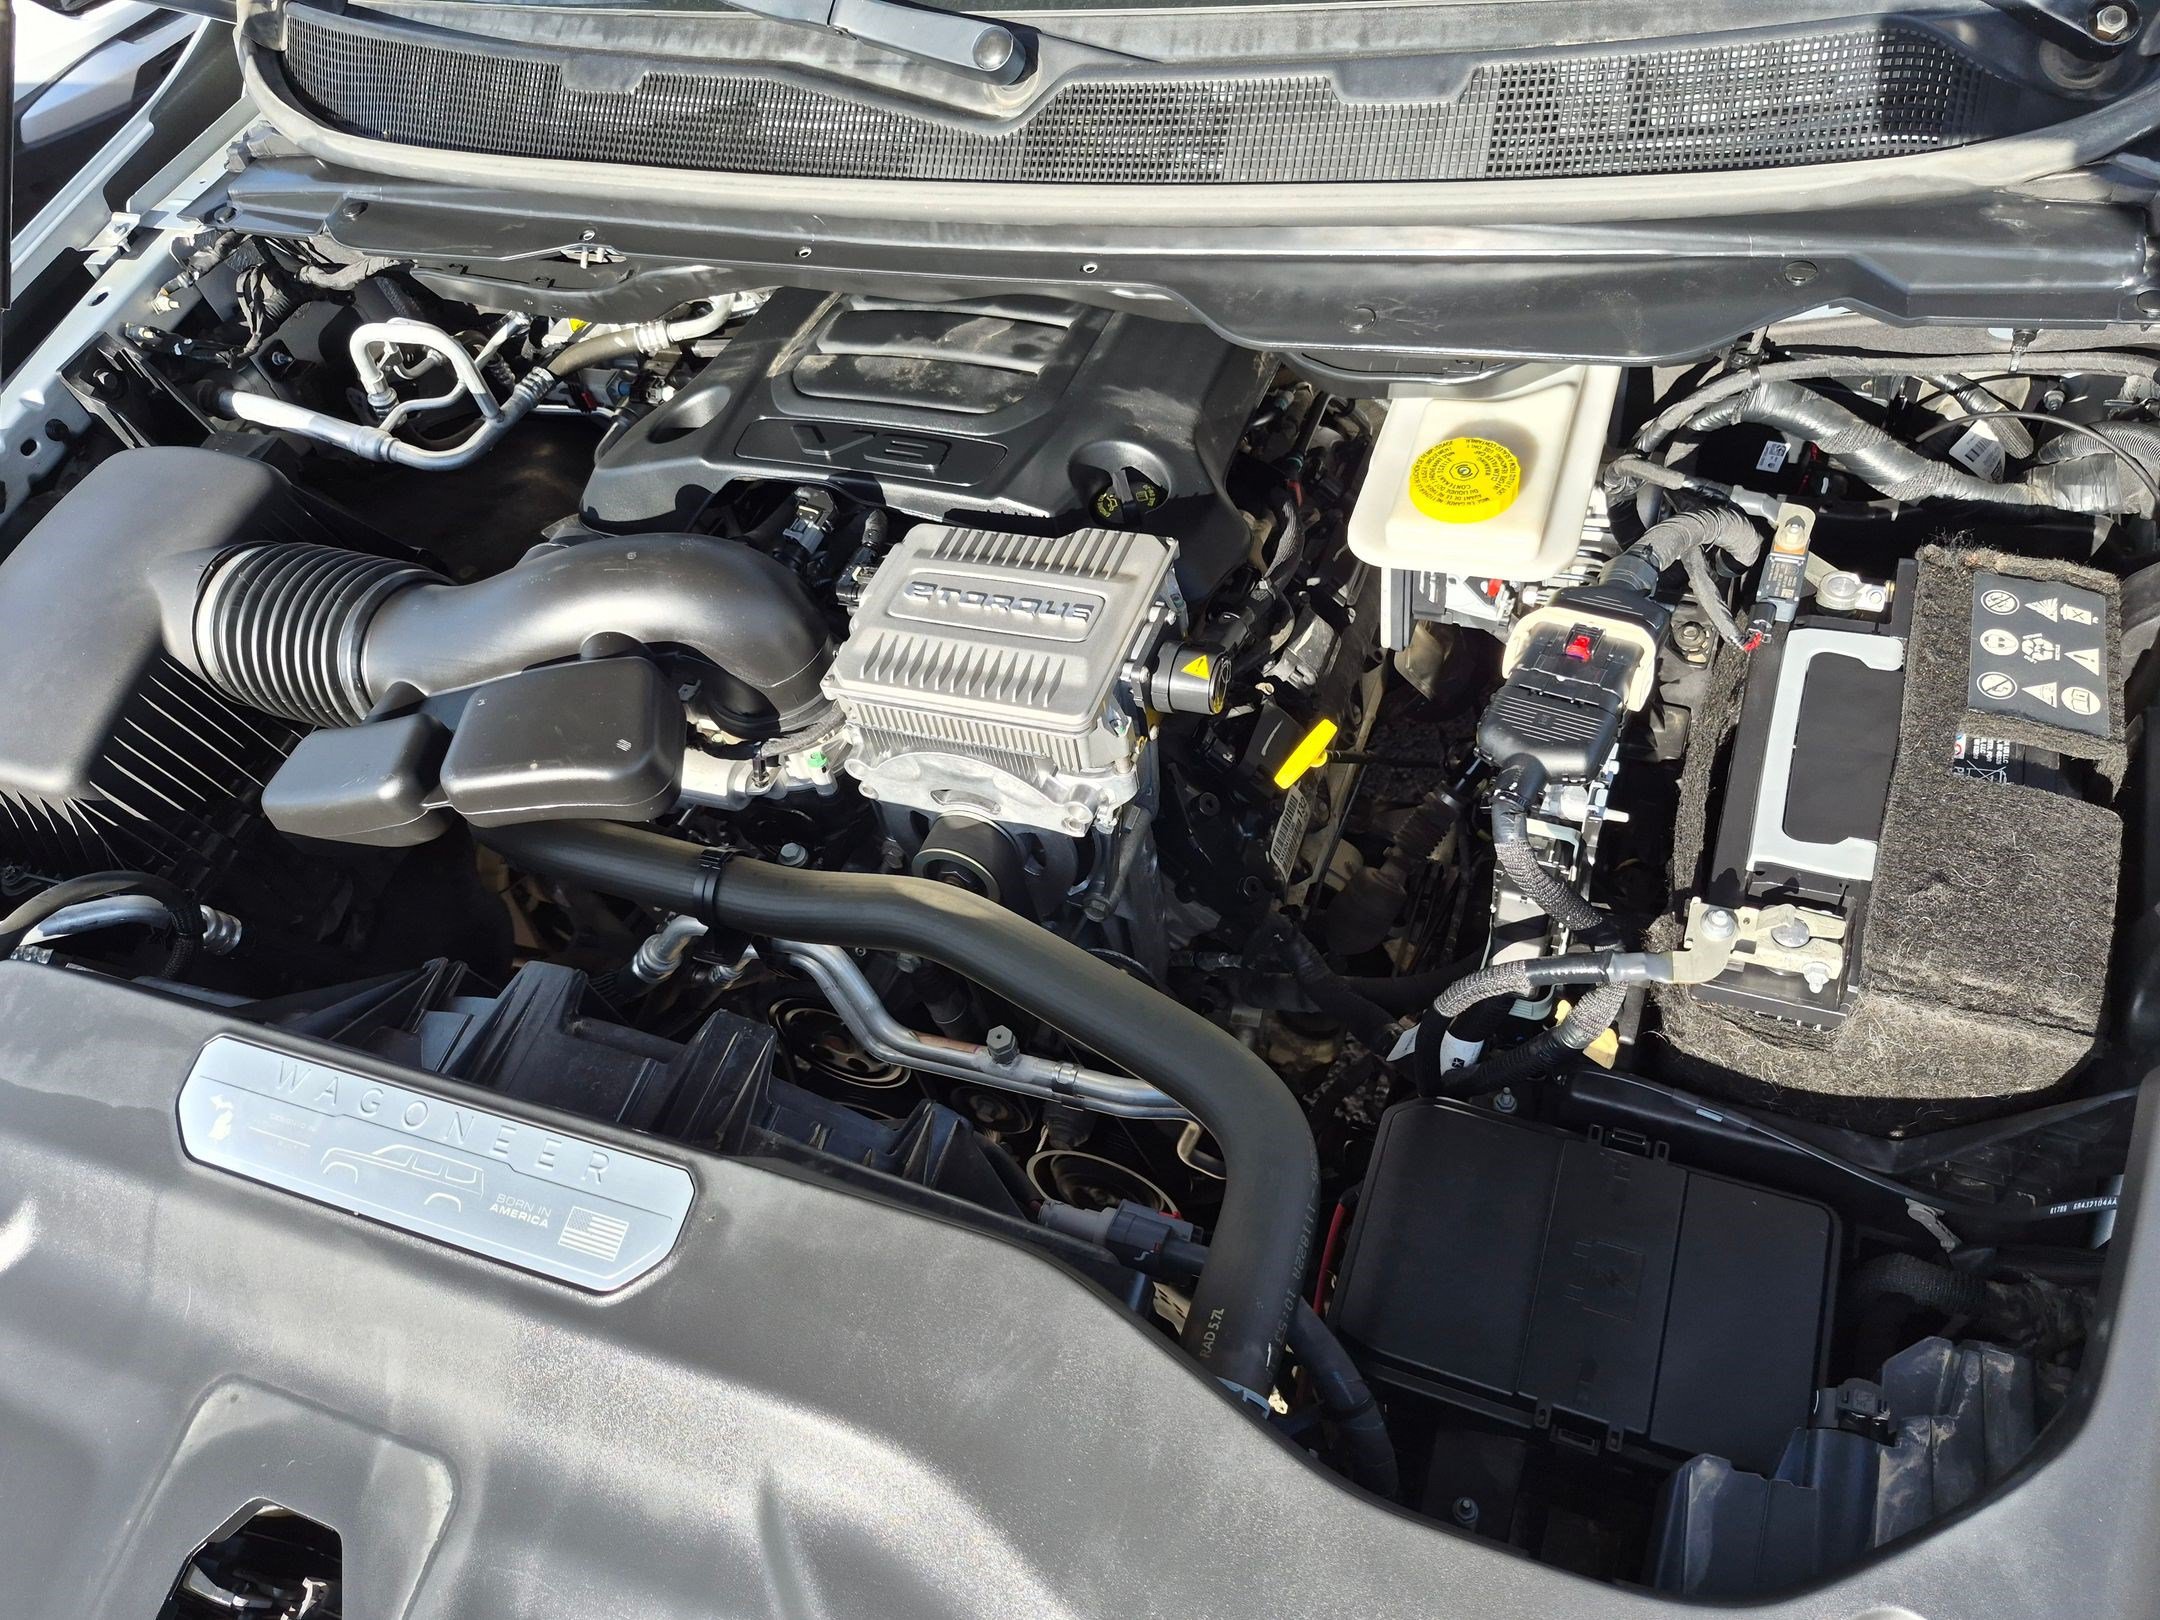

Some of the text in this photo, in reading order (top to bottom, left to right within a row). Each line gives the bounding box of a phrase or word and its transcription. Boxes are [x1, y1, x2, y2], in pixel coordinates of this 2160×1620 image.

[276, 1058, 612, 1186] WAGONEER
[489, 1203, 549, 1228] AMERICA
[496, 1193, 552, 1218] BORN IN
[1200, 1331, 1216, 1358] RAD
